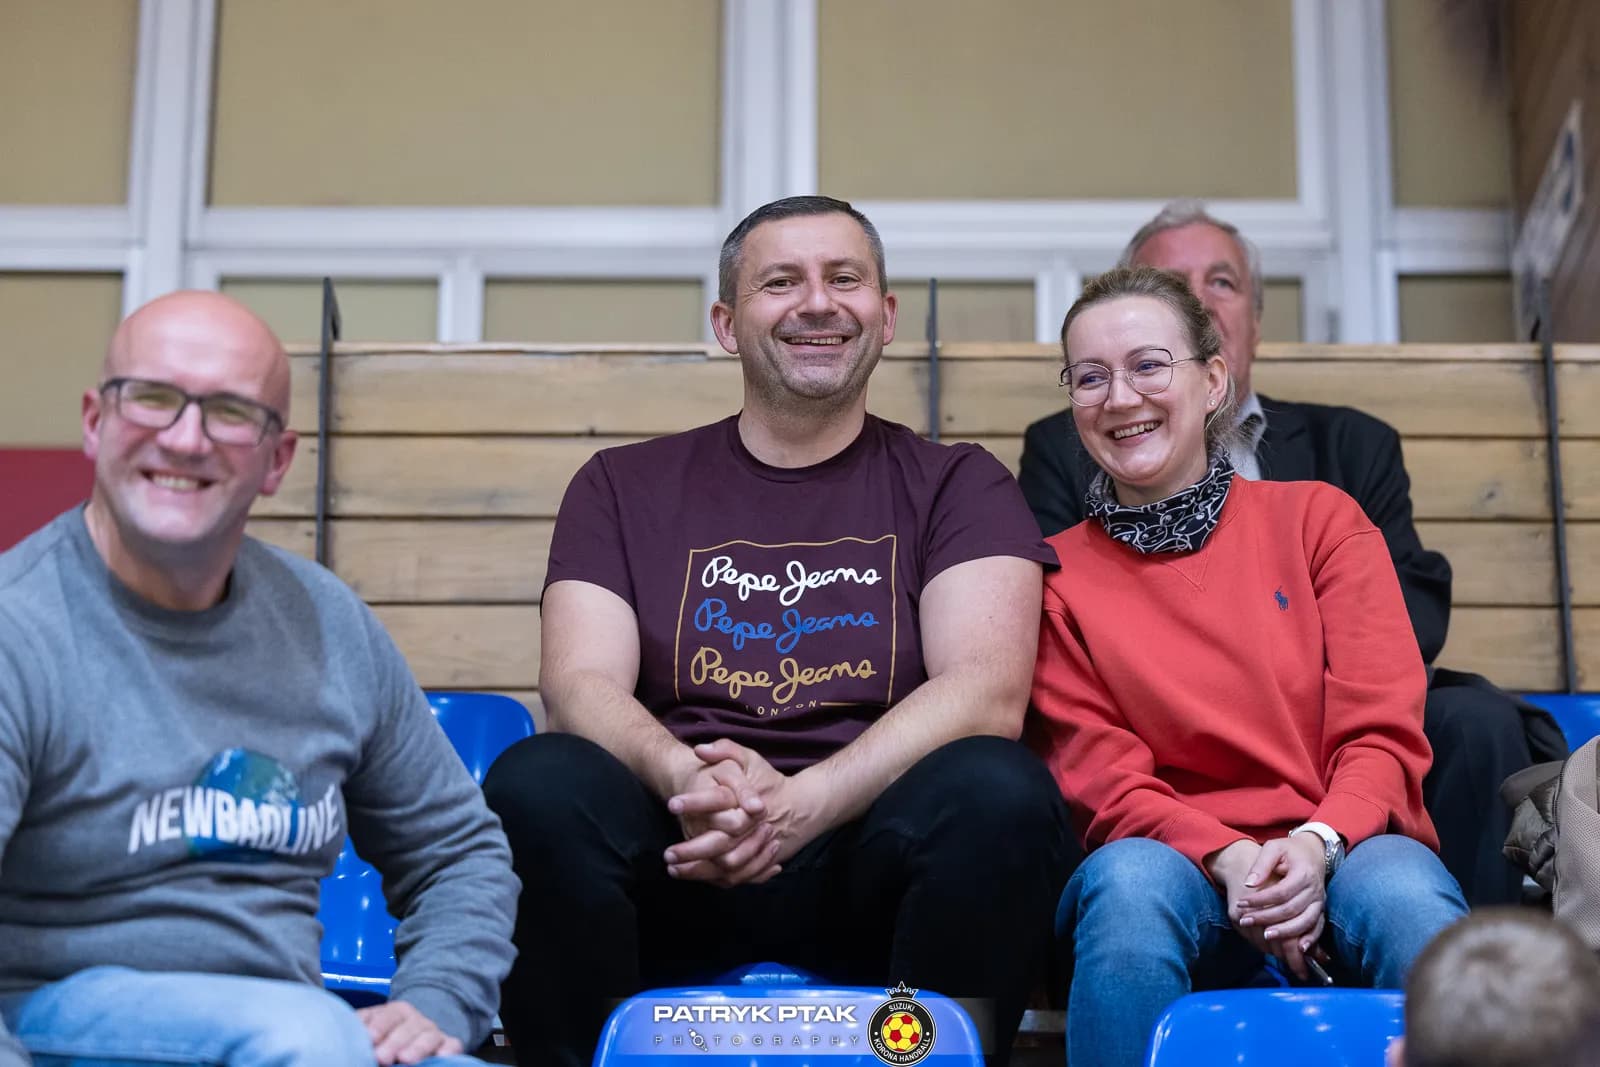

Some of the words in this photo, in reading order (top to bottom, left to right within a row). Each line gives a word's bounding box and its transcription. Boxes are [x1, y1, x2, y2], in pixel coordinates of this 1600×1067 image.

[701, 555, 780, 601] Pepe
[779, 560, 882, 606] Jeans
[694, 598, 776, 650] Pepe
[775, 608, 879, 654] Jeans
[690, 646, 773, 699] Pepe
[772, 657, 877, 704] Jeans
[745, 700, 817, 716] ONON
[128, 784, 341, 855] NEWBADLINE
